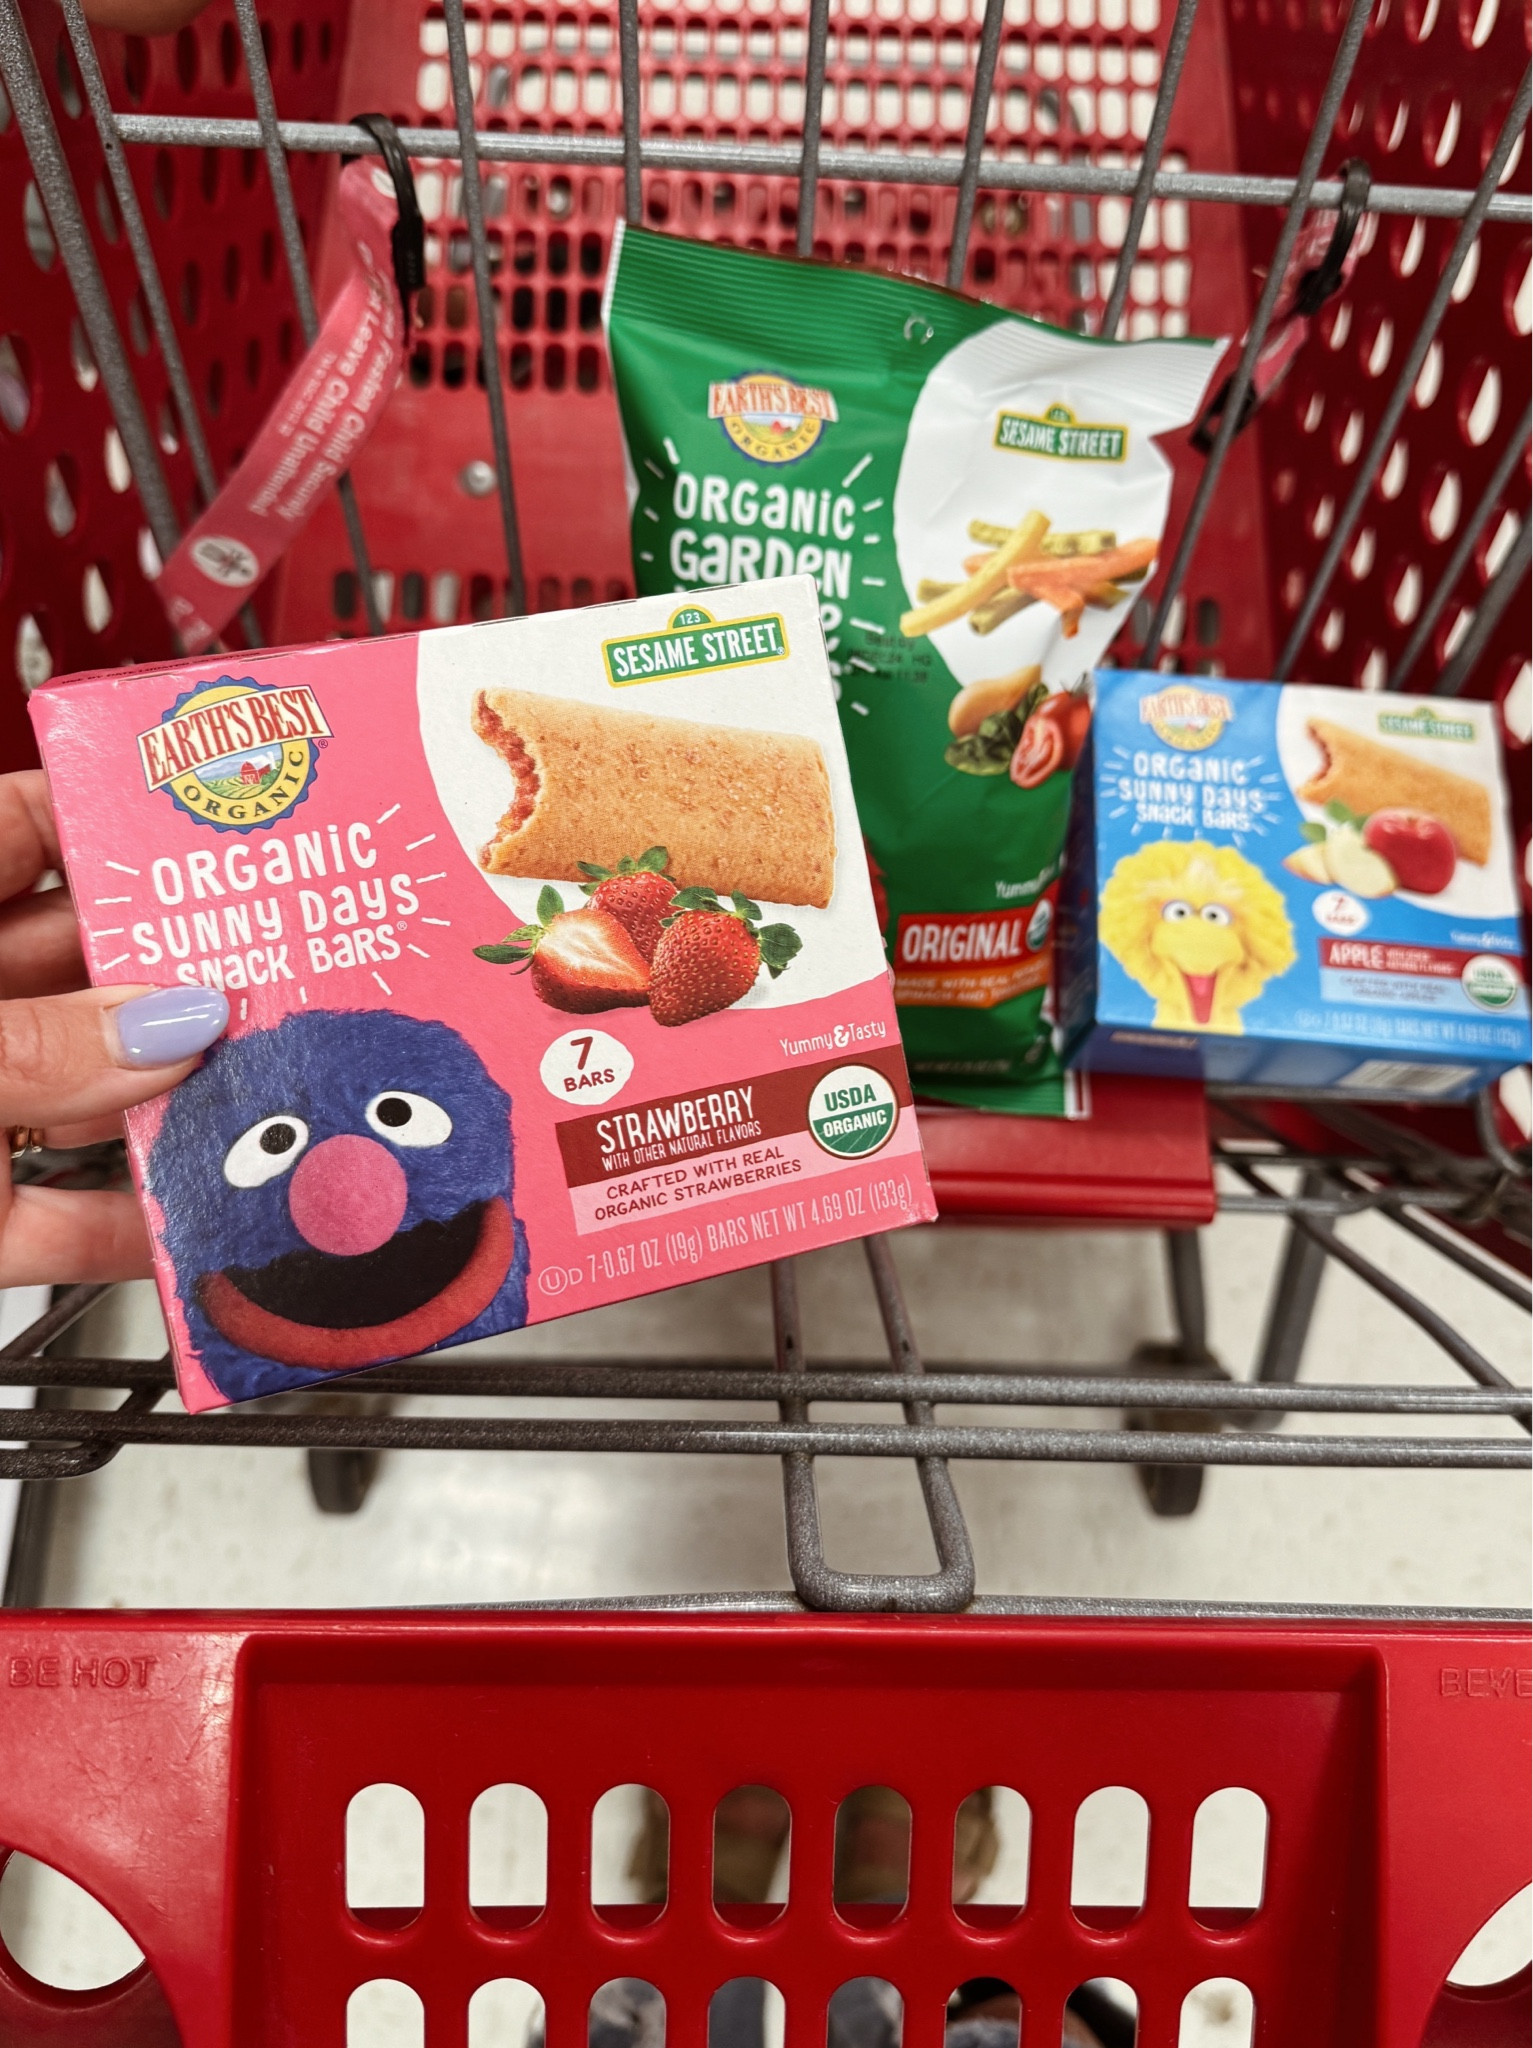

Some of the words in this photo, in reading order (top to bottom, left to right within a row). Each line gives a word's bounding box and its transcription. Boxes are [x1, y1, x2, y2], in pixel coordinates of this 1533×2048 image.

[336, 310, 380, 377] Leave
[303, 376, 350, 436] Child
[713, 383, 786, 416] EARTH'S
[787, 386, 832, 419] BEST
[323, 411, 366, 464] Child
[999, 417, 1055, 454] SESAME
[1058, 429, 1123, 459] STREET
[679, 611, 701, 625] 123
[613, 636, 700, 677] SESAME
[141, 701, 255, 786] EARTH'S
[245, 688, 325, 743] BEST
[183, 750, 305, 820] ORGANIC
[901, 918, 1024, 963] ORIGINAL
[1328, 942, 1386, 970] APPLE
[569, 1035, 593, 1071] 7
[563, 1067, 616, 1093] BARS
[823, 1083, 877, 1112] USDA
[596, 1085, 755, 1154] STRAWBERRY
[822, 1109, 888, 1138] ORGANIC
[601, 1151, 630, 1172] WITH
[634, 1143, 666, 1165] OTHER
[669, 1131, 714, 1156] NATURAL
[716, 1120, 762, 1146] FLAVORS
[595, 1191, 669, 1221] ORGANIC
[674, 1158, 802, 1202] STRAWBERRIES
[606, 1168, 688, 1200] CRAFTED
[693, 1156, 737, 1178] WITH
[743, 1145, 785, 1167] REAL
[586, 1243, 637, 1284] 7-0.67
[640, 1238, 663, 1269] OZ
[664, 1224, 704, 1266] (19g)
[706, 1216, 750, 1253] BARS
[752, 1210, 780, 1242] NET
[782, 1201, 806, 1232] WT
[811, 1192, 843, 1226] 4.69
[849, 1186, 867, 1217] OZ
[869, 1173, 914, 1215] (133g)
[9, 1656, 60, 1688] BE
[72, 1656, 158, 1689] HOT
